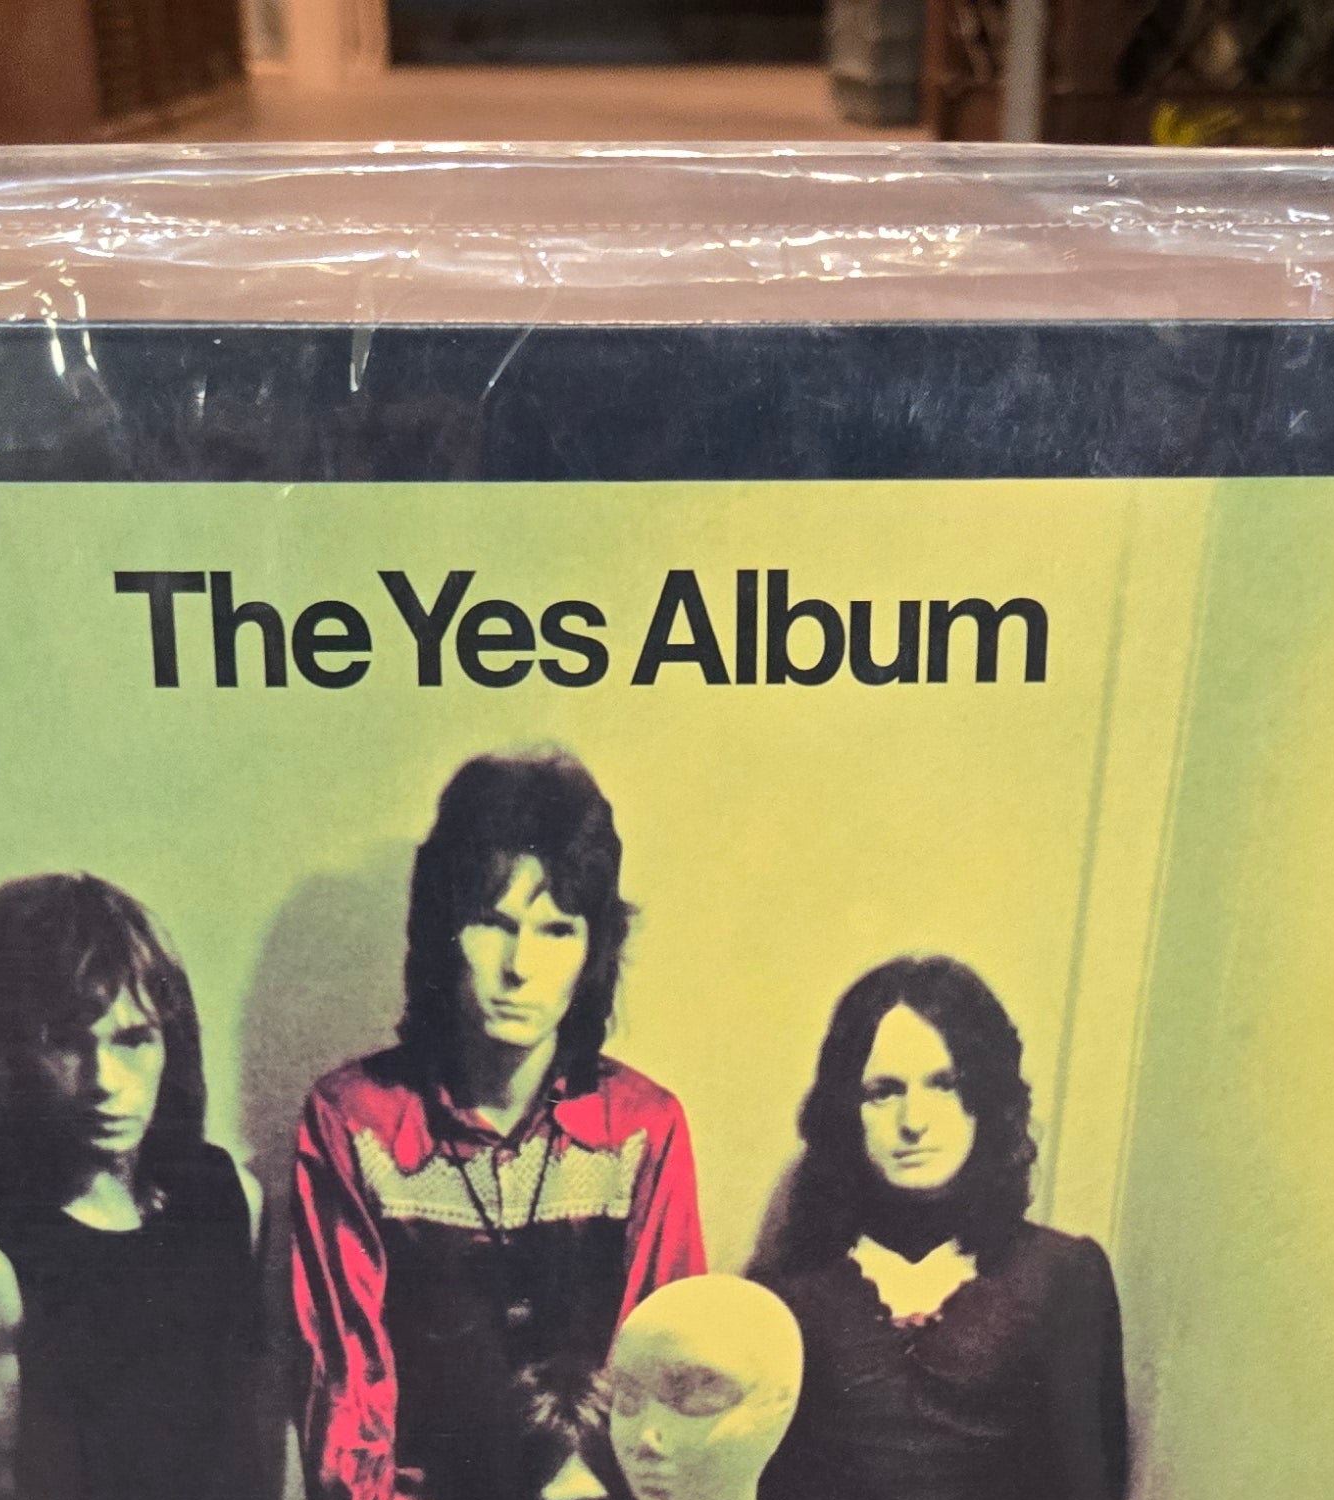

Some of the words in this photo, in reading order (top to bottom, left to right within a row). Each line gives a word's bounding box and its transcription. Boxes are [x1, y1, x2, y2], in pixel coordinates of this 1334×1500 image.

[114, 570, 373, 688] The
[378, 570, 609, 688] Yes
[631, 569, 1048, 686] Album
